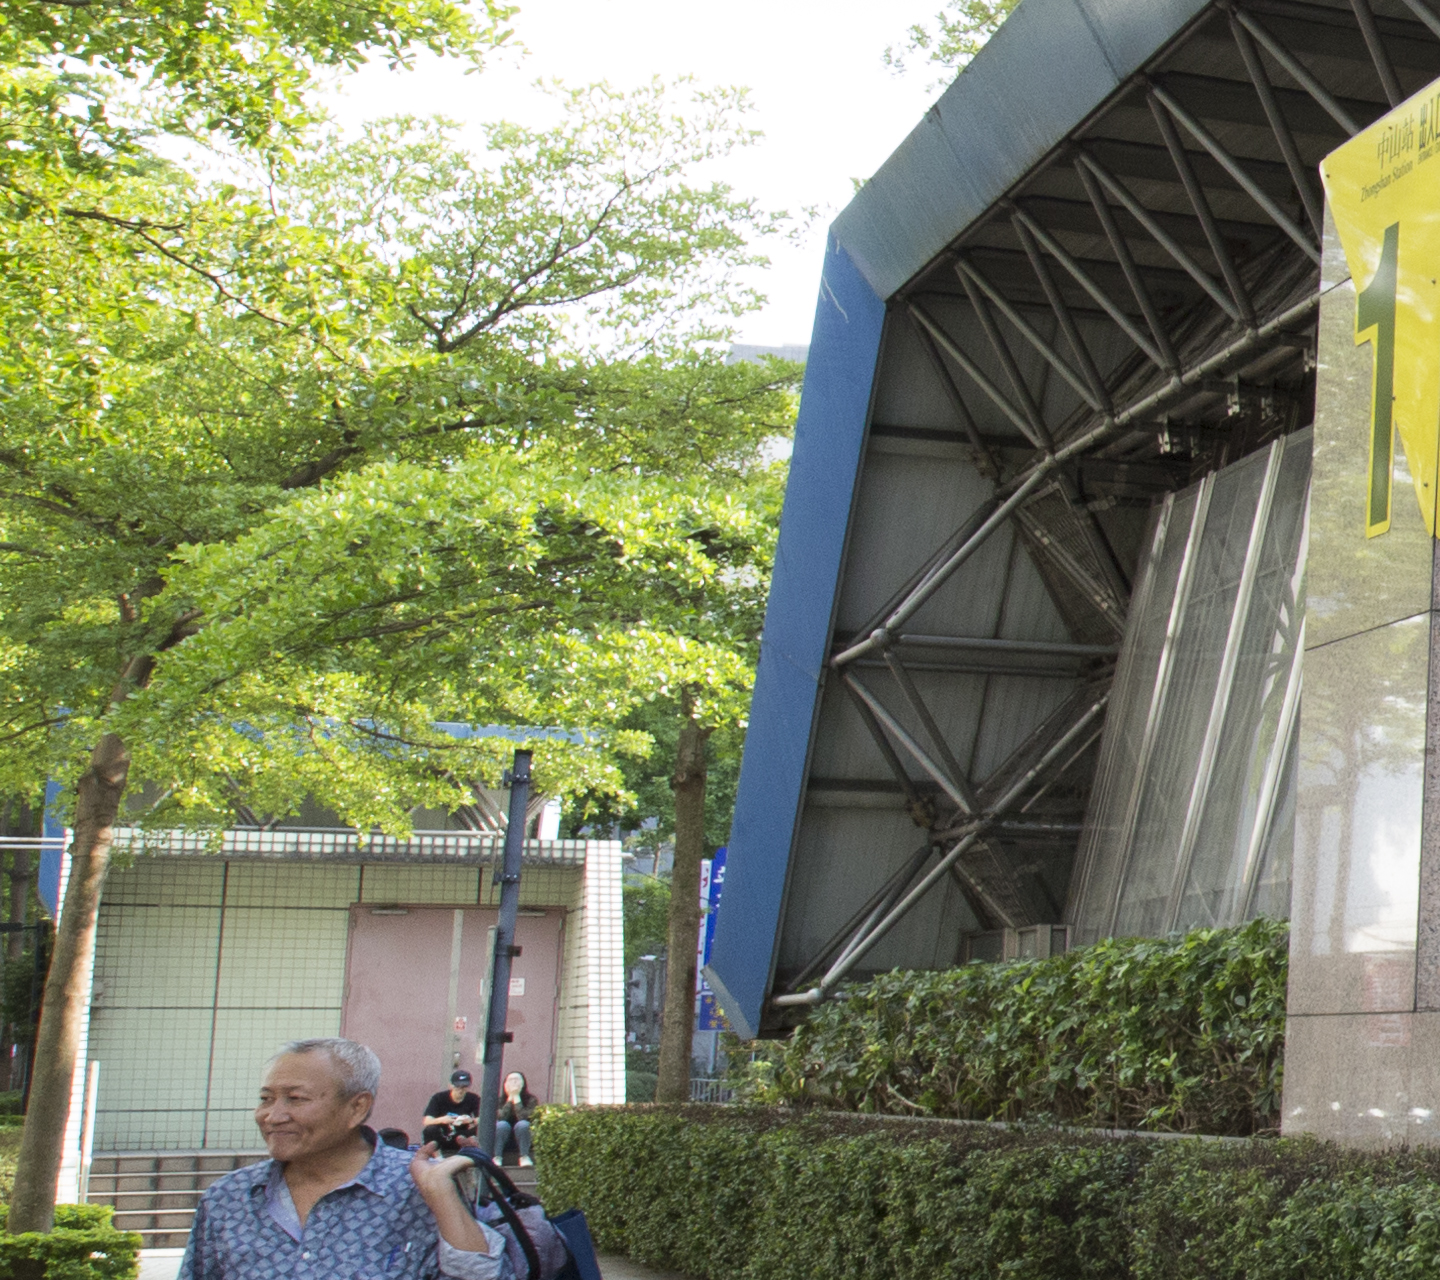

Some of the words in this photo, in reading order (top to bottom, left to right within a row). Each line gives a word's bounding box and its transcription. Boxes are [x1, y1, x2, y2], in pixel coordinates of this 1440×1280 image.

[1377, 112, 1414, 169] 中山站
[1357, 221, 1399, 528] 1
